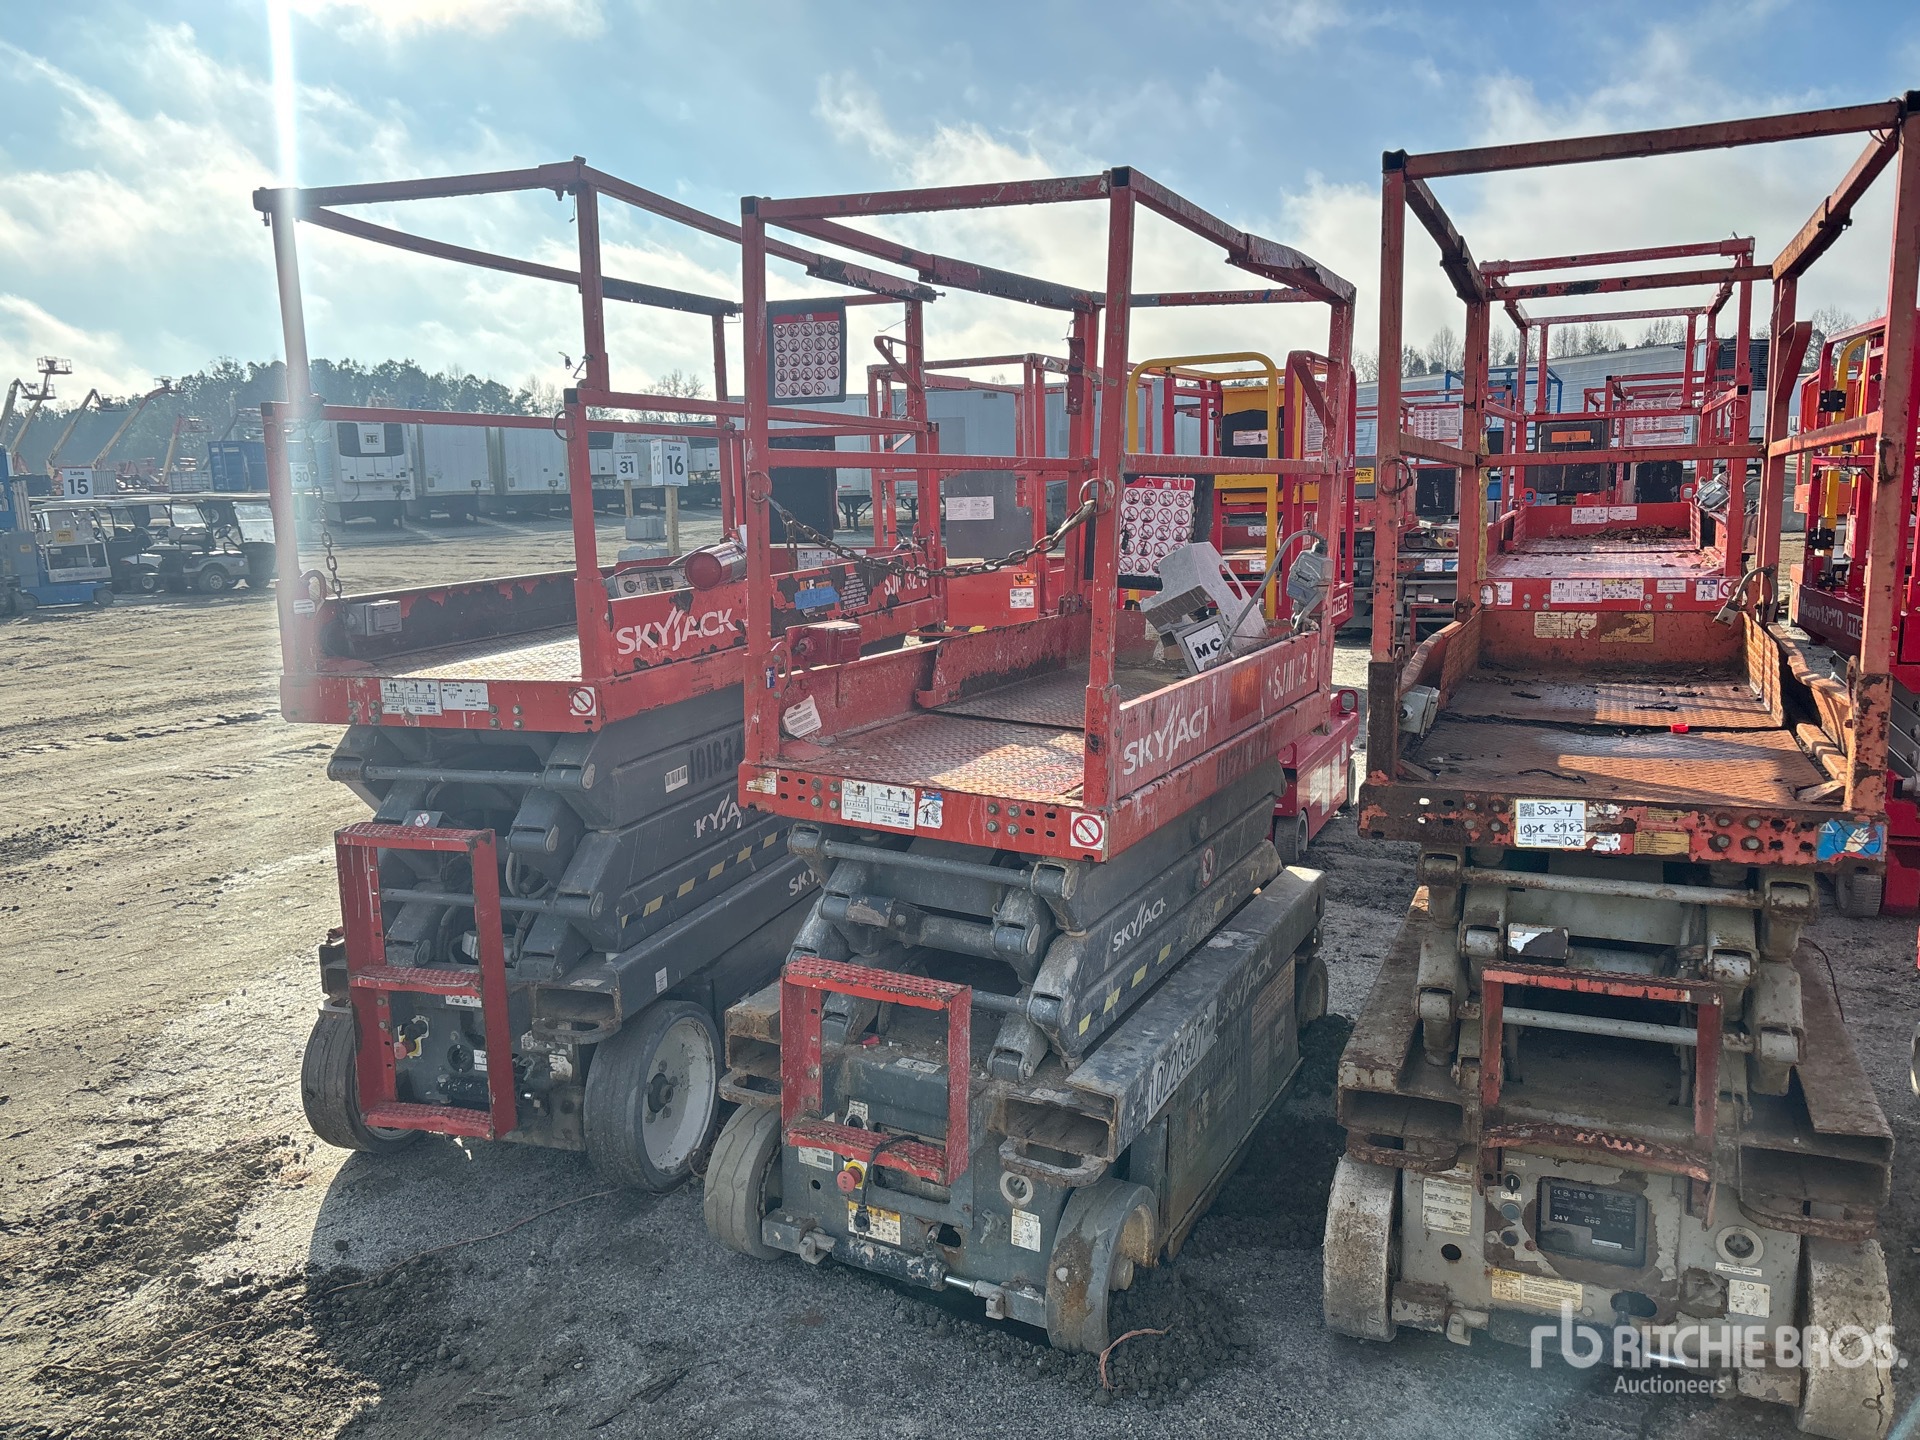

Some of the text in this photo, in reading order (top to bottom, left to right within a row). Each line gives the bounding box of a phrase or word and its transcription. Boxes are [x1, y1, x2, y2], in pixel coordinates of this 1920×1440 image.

[620, 461, 634, 473] 31
[653, 456, 661, 475] 16
[667, 455, 684, 475] 16
[295, 472, 310, 482] 30
[68, 479, 88, 494] 15
[616, 606, 739, 655] SKYJACK
